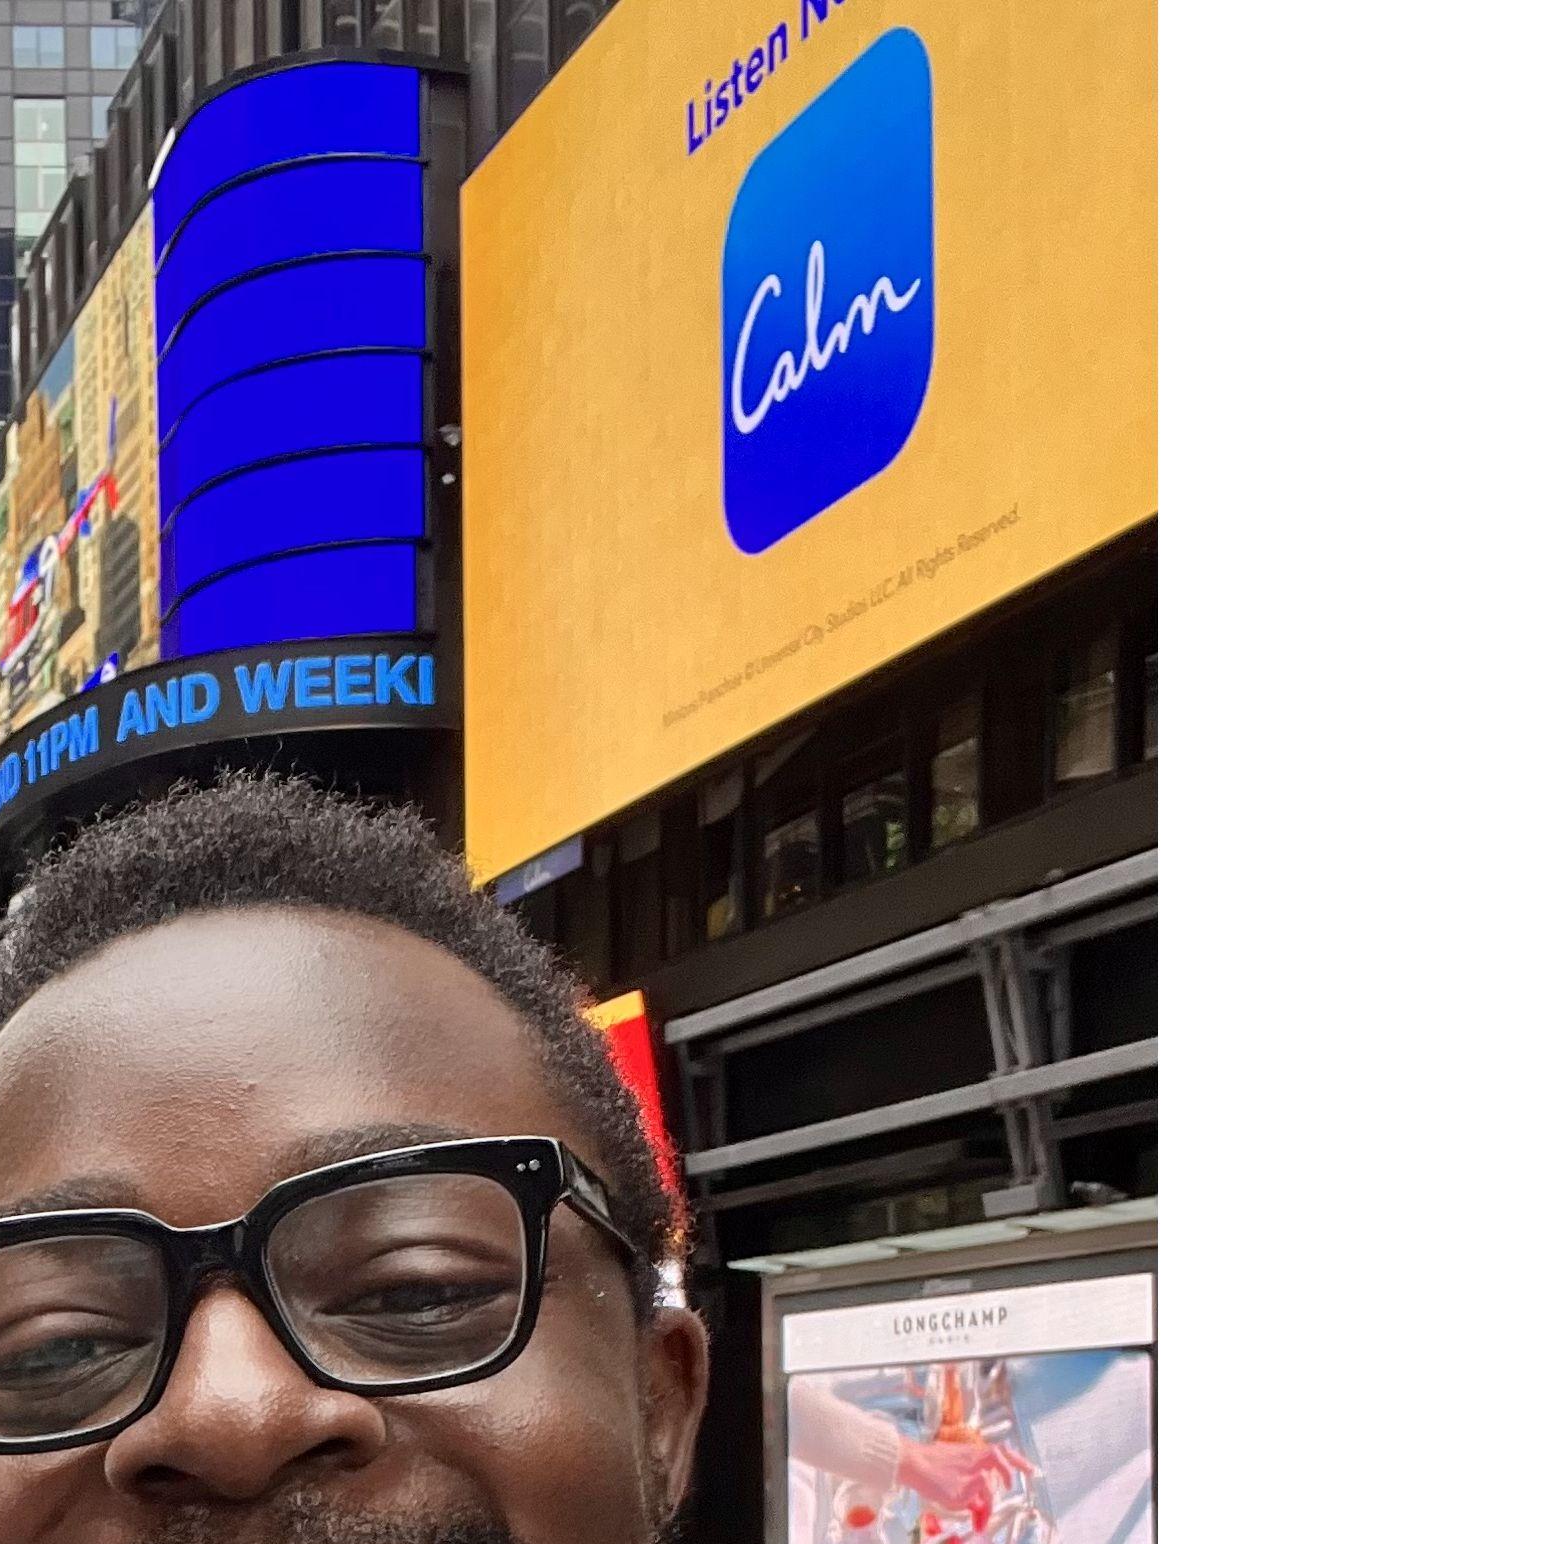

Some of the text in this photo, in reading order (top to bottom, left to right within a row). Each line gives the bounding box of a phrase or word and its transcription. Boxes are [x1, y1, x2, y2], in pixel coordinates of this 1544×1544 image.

[686, 0, 847, 156] Listen N
[732, 240, 921, 434] Calm
[24, 704, 99, 785] 11PM
[117, 672, 220, 743] AND
[894, 1306, 1008, 1335] LONGCHAMP
